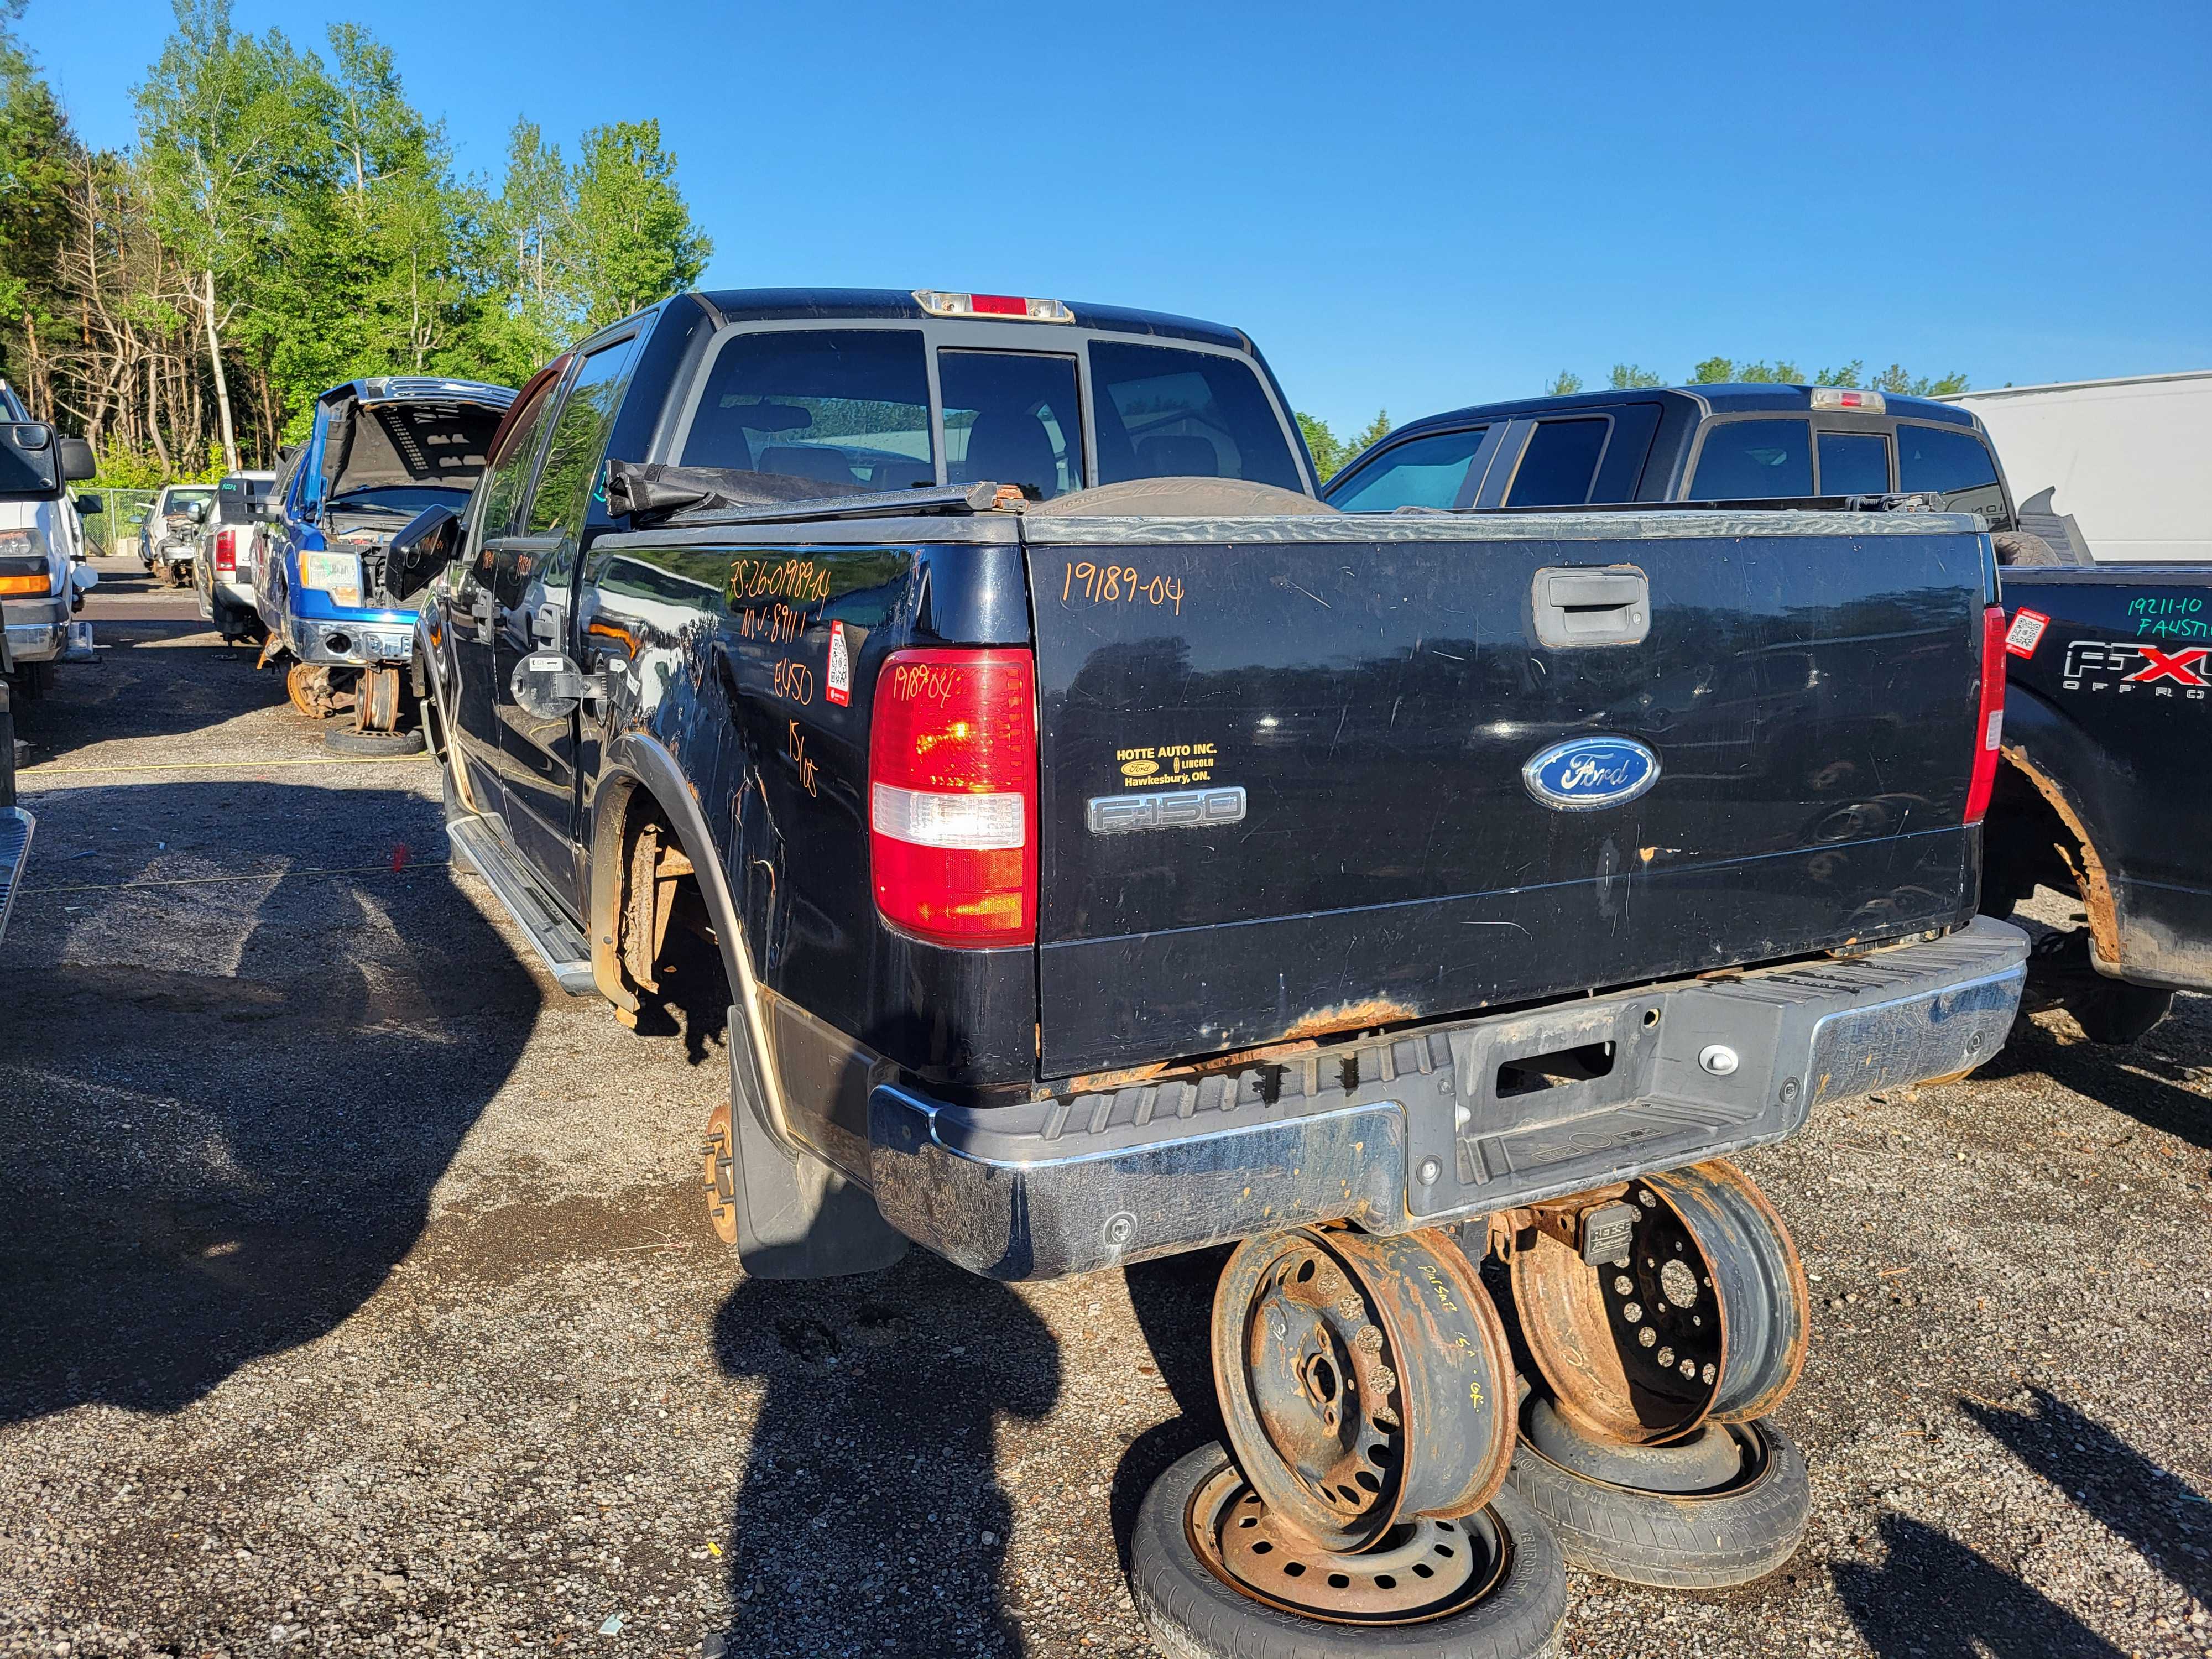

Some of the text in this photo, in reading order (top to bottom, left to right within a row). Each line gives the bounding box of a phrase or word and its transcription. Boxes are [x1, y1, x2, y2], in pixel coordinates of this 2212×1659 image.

[1063, 562, 1185, 615] 19189-04
[2128, 598, 2202, 615] 19211-10
[2063, 680, 2205, 700] OFF RO
[1117, 743, 1217, 761] HOTTE AUTO INC.
[1129, 758, 1214, 773] Ford LINCOLN
[1561, 753, 1630, 790] Ford
[1125, 771, 1211, 787] Hawkesbury, ON.
[1092, 790, 1244, 830] F-150
[1593, 1220, 1631, 1241] REESE
[1555, 1477, 1609, 1506] USE
[1508, 1529, 1537, 1594] TEMPORARY
